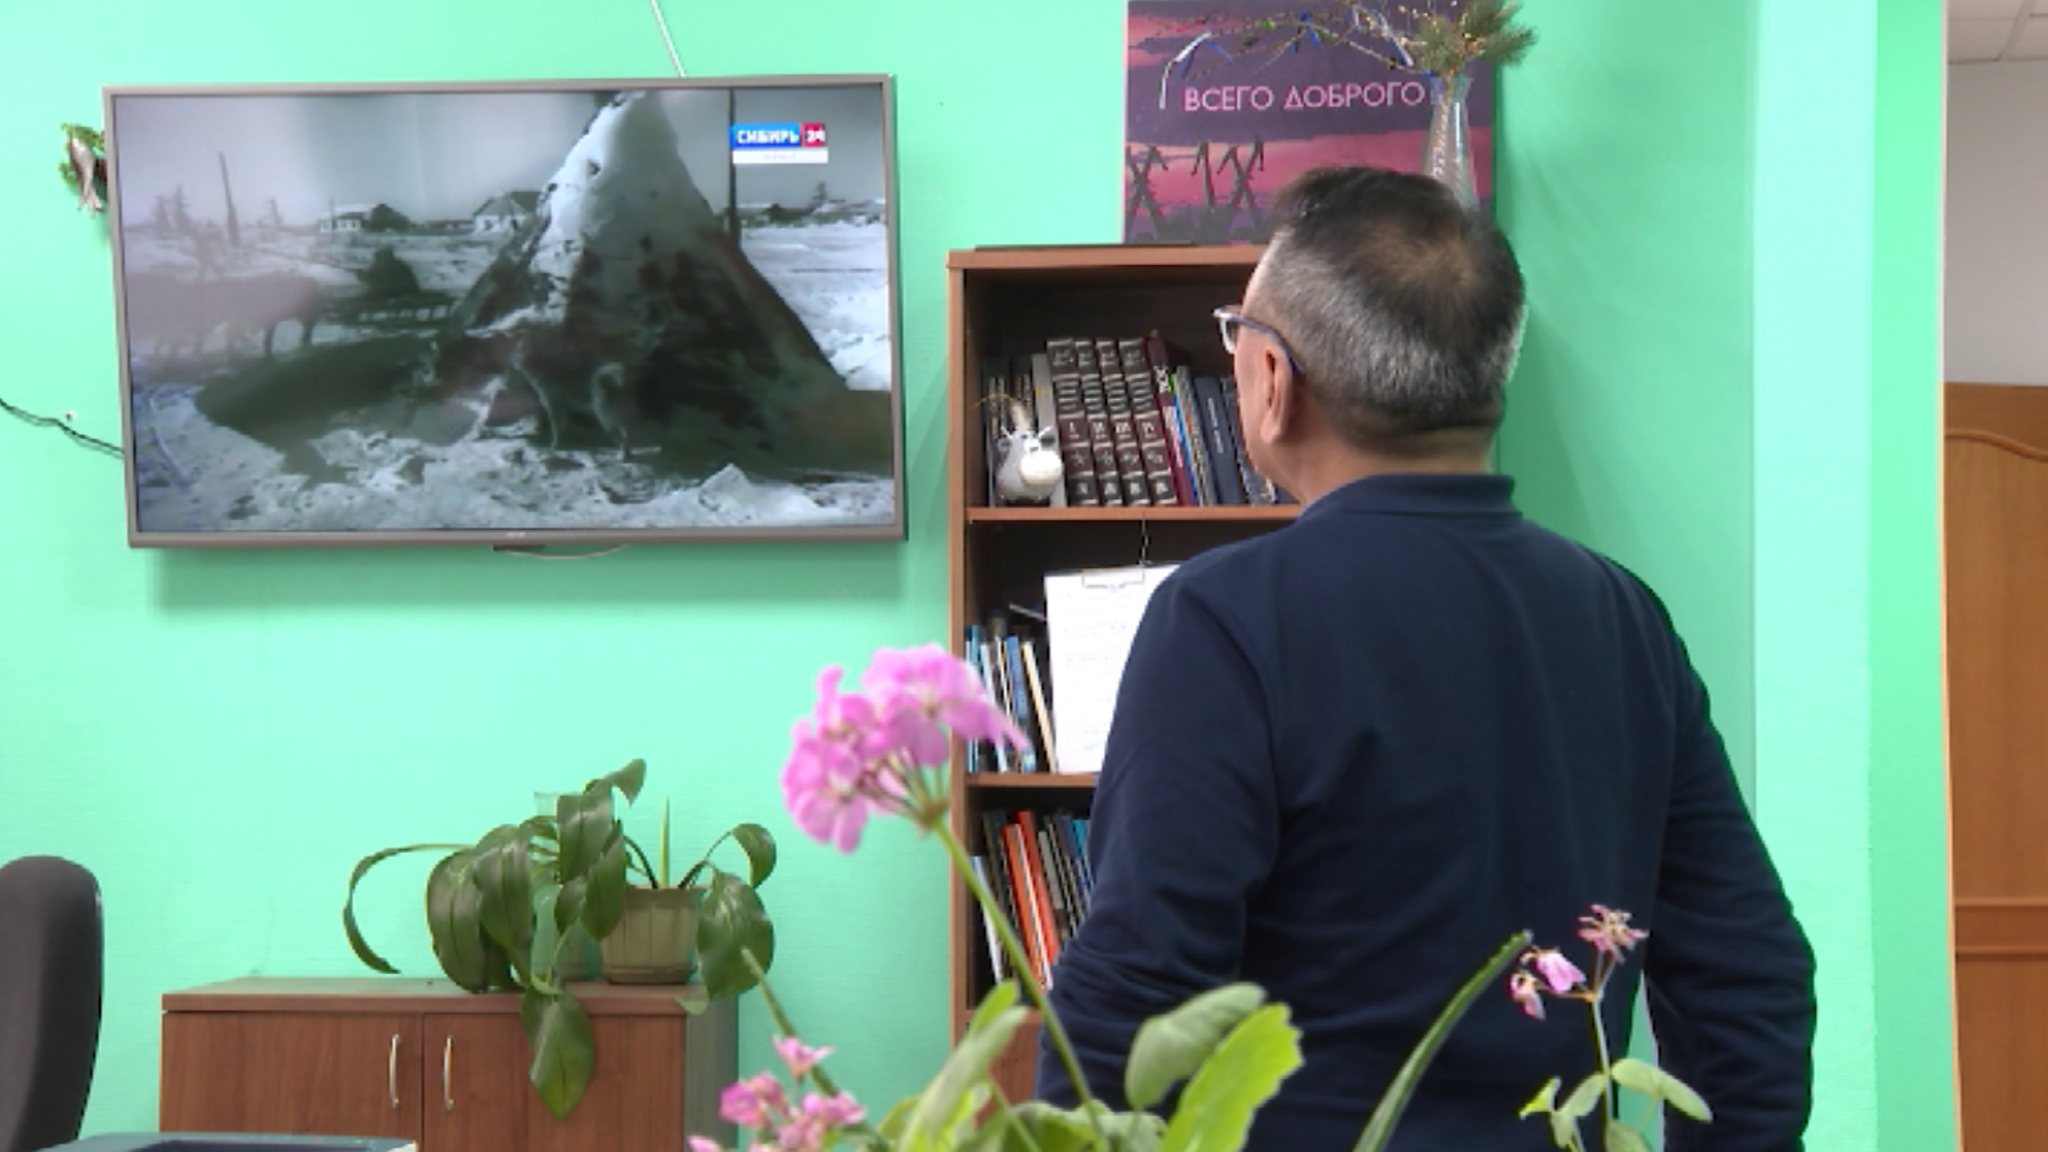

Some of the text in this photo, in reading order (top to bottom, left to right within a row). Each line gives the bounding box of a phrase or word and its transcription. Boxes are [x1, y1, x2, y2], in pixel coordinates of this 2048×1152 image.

[1184, 81, 1426, 111] ВСЕГО ДОБРОГО
[735, 129, 826, 143] СИБИРЬ 24
